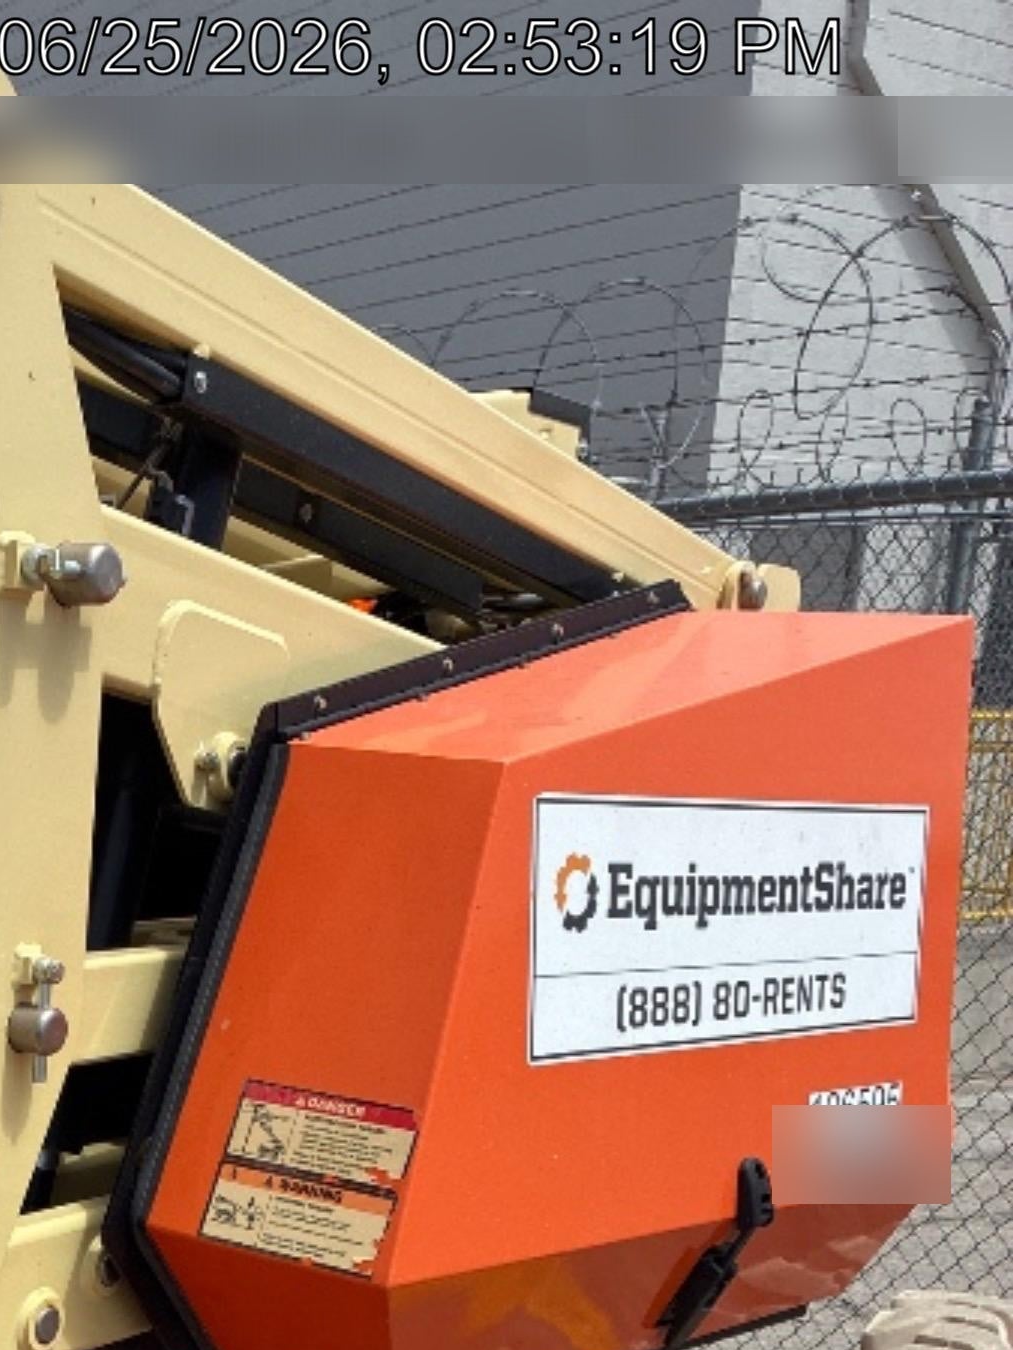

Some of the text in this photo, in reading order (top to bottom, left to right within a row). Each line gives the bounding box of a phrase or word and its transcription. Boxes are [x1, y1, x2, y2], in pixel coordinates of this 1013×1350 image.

[606, 861, 907, 931] EquipmentShare
[616, 973, 847, 1032] (888) 80-RENTS
